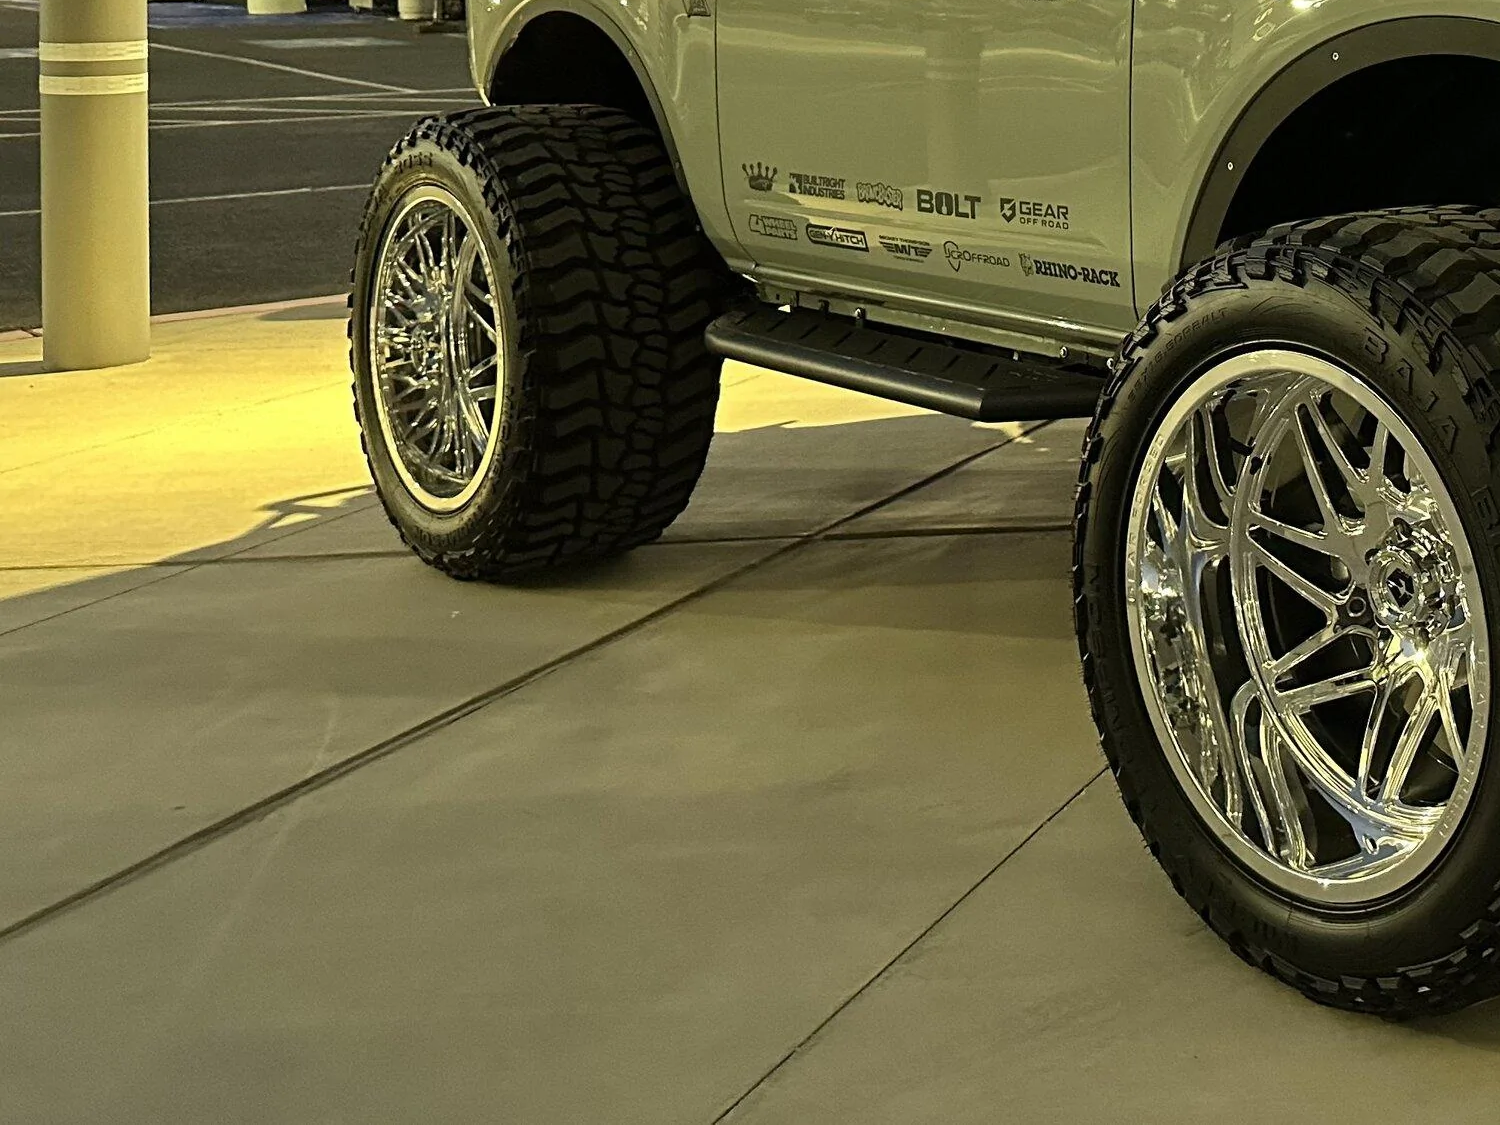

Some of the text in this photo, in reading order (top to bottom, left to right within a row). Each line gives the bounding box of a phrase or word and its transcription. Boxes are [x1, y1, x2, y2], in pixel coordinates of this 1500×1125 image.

[804, 174, 846, 188] BUILTRIGHT
[803, 187, 846, 200] INDUSTRIES
[916, 189, 982, 219] BOLT
[1019, 201, 1069, 220] GEAR
[749, 214, 766, 236] 4
[761, 216, 797, 232] WHEEL
[1020, 217, 1069, 230] OFF ROAD
[834, 232, 865, 246] HITCH
[1033, 259, 1121, 287] RHINO-RACK
[1363, 318, 1463, 456] BAJA
